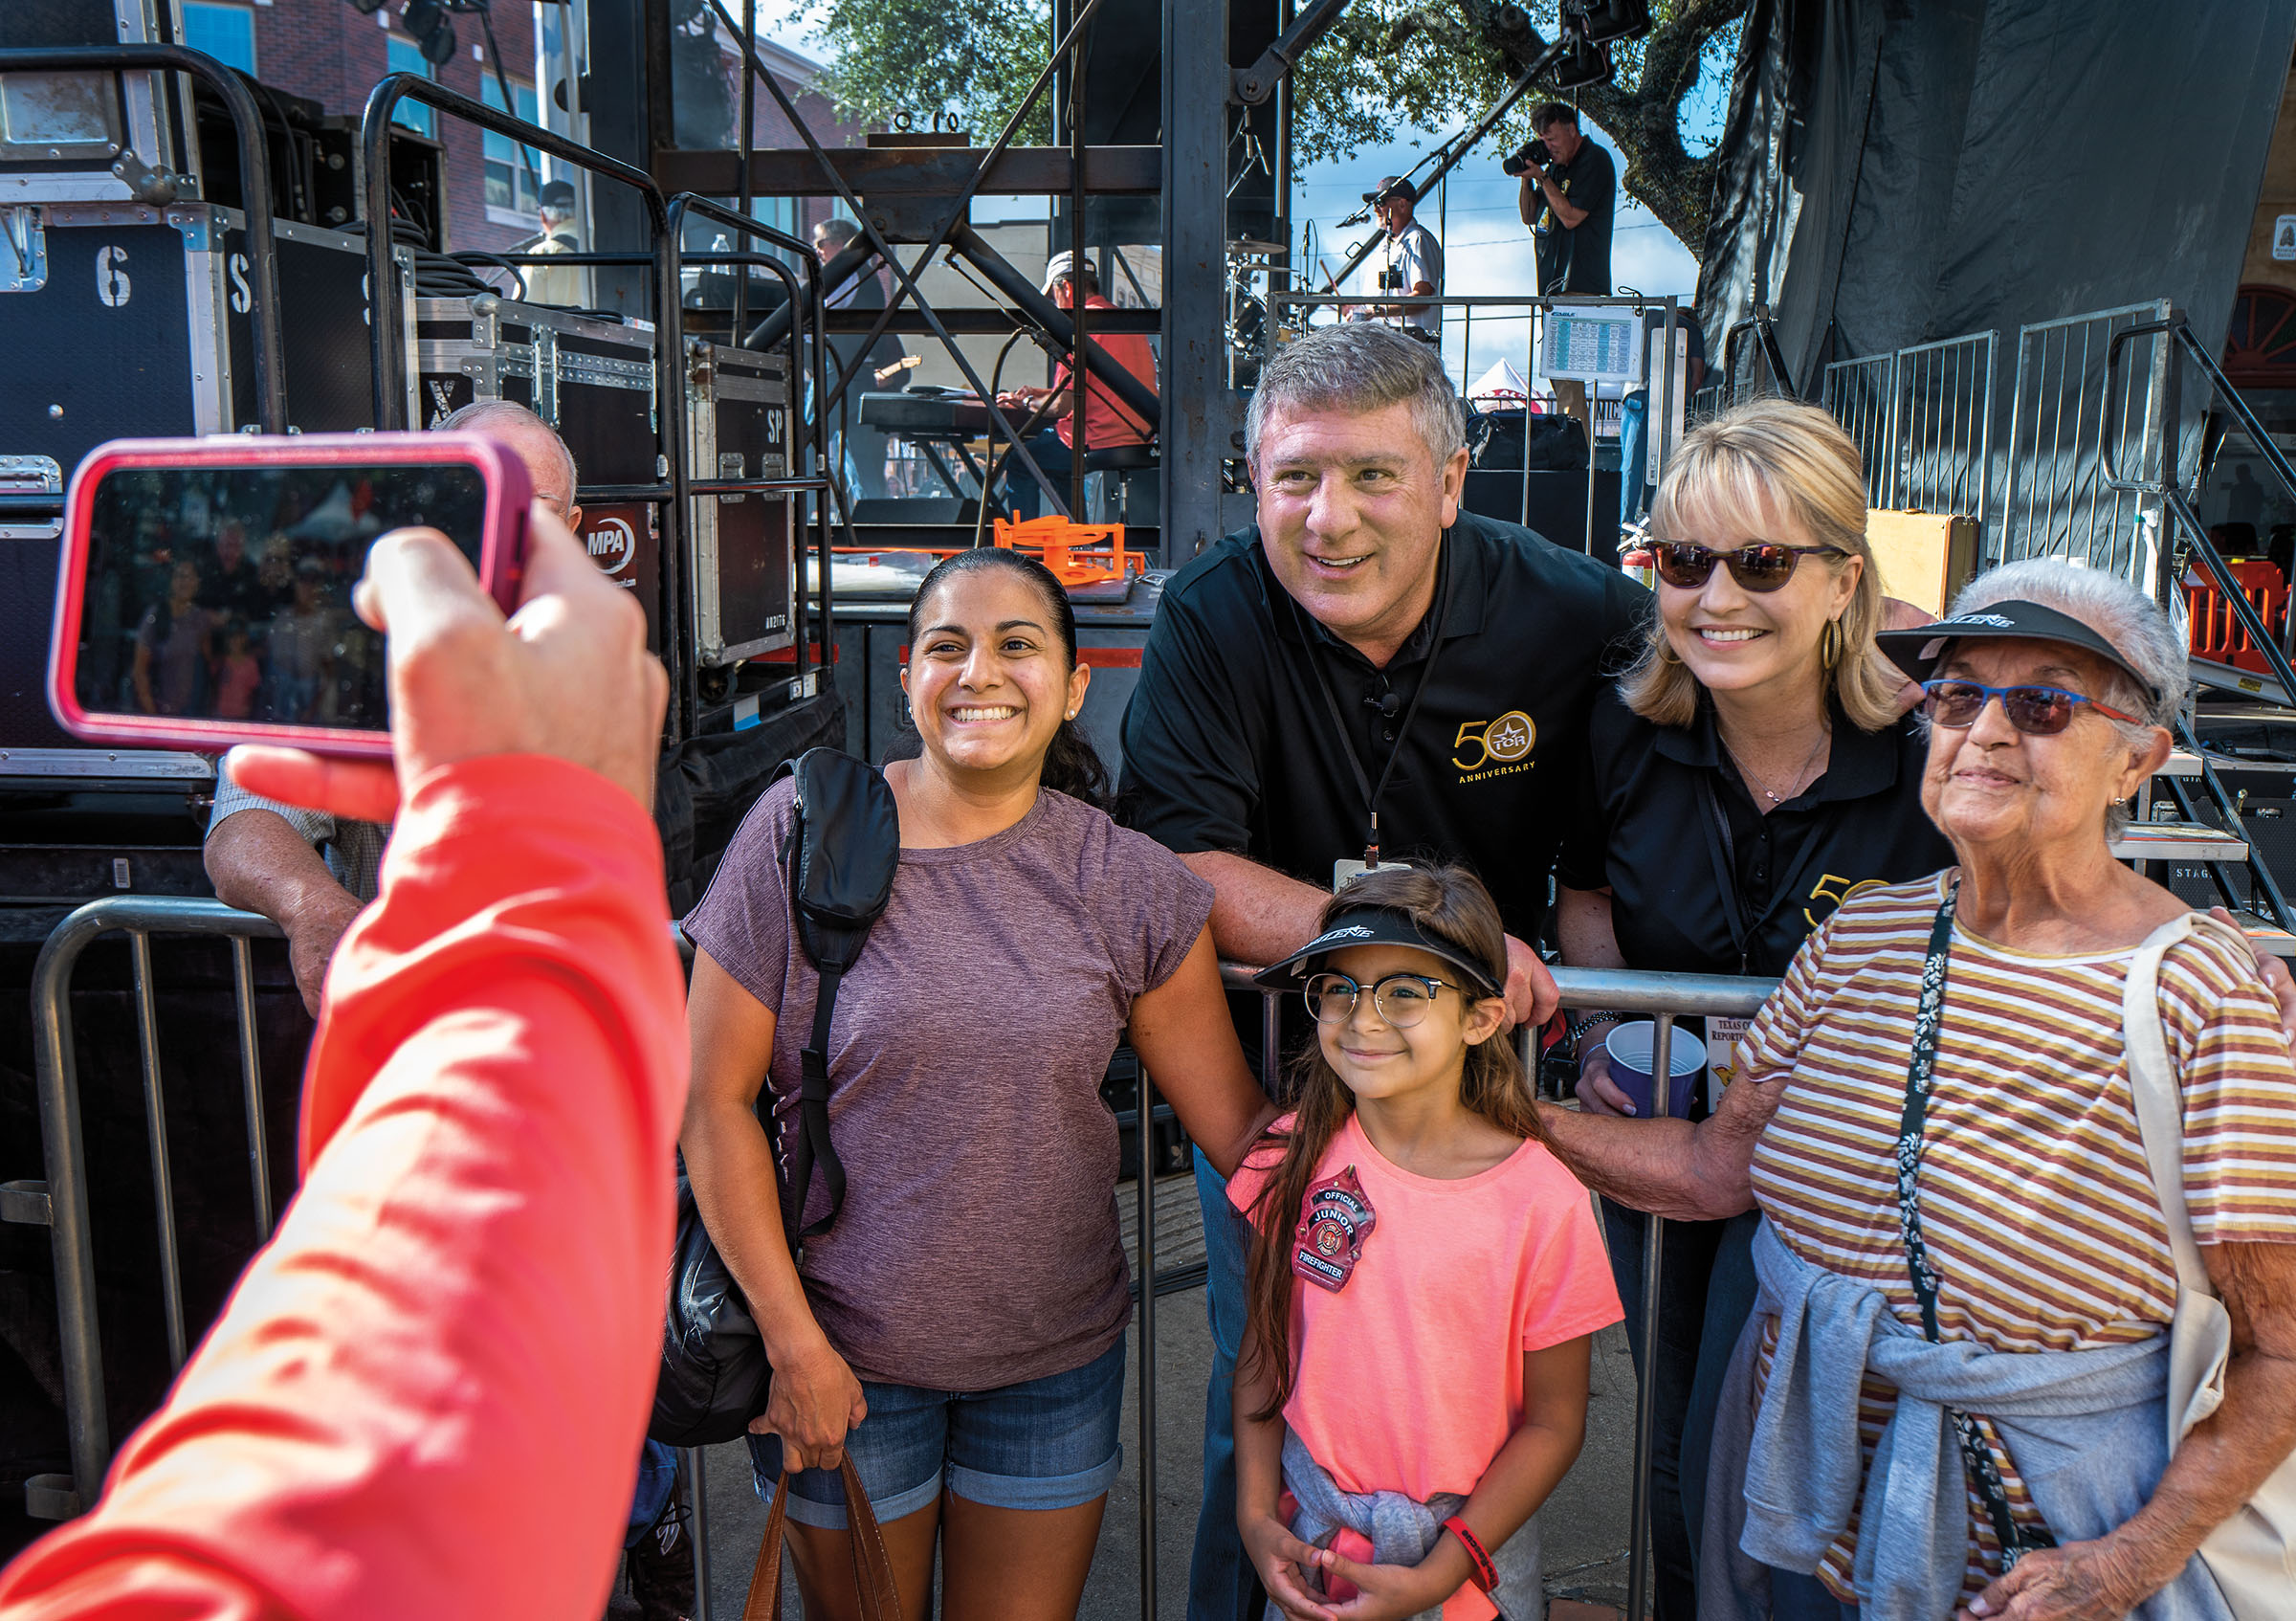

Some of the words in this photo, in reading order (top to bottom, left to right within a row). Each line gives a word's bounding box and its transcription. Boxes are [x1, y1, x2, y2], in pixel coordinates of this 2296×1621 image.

[97, 245, 131, 307] 6
[767, 409, 783, 444] SP
[587, 529, 625, 556] MPA
[1452, 710, 1536, 771] 50
[1459, 761, 1535, 784] ANNIVERSARY
[2176, 868, 2212, 878] STAG
[1803, 874, 1890, 927] 5
[1711, 1031, 1744, 1042] REPORTE
[1718, 1020, 1741, 1031] TEXAS
[1324, 1191, 1358, 1212] OFFICIAL
[1314, 1210, 1354, 1236] JUNIOR
[1299, 1251, 1343, 1279] FIREFIGHTER
